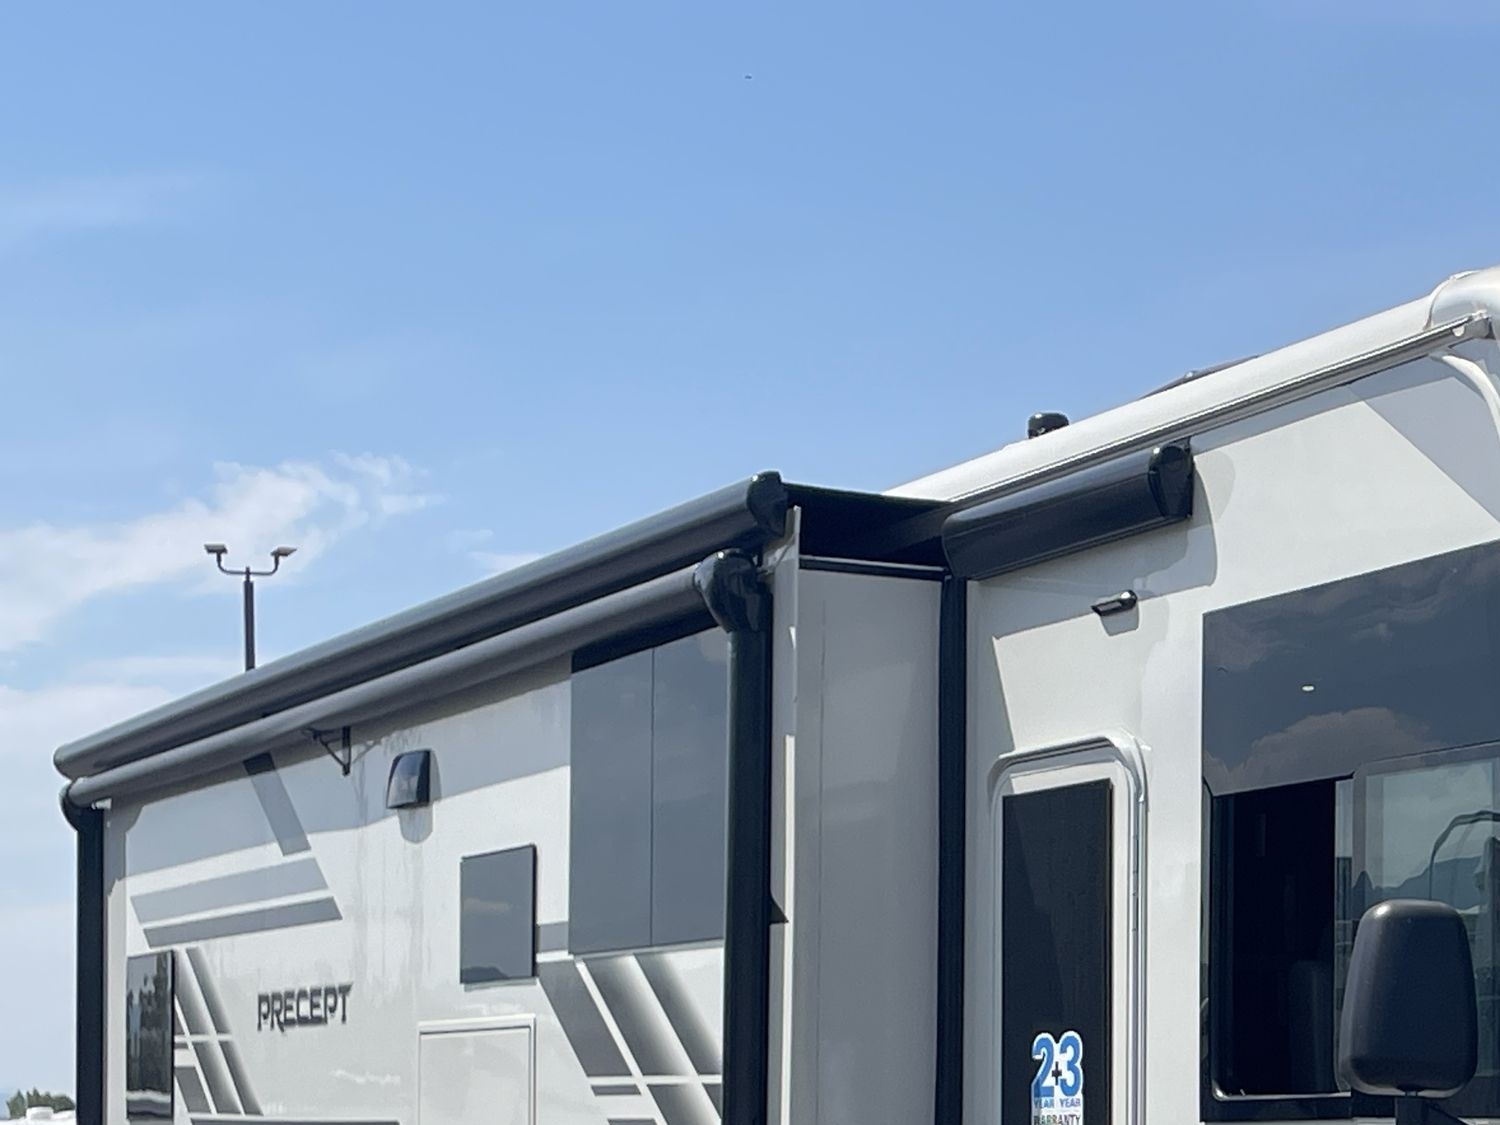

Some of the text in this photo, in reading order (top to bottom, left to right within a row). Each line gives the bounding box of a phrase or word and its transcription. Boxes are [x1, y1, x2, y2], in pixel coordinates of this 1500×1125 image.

[257, 983, 352, 1033] PRECEPT
[1034, 1098, 1081, 1108] YEAR YEAR
